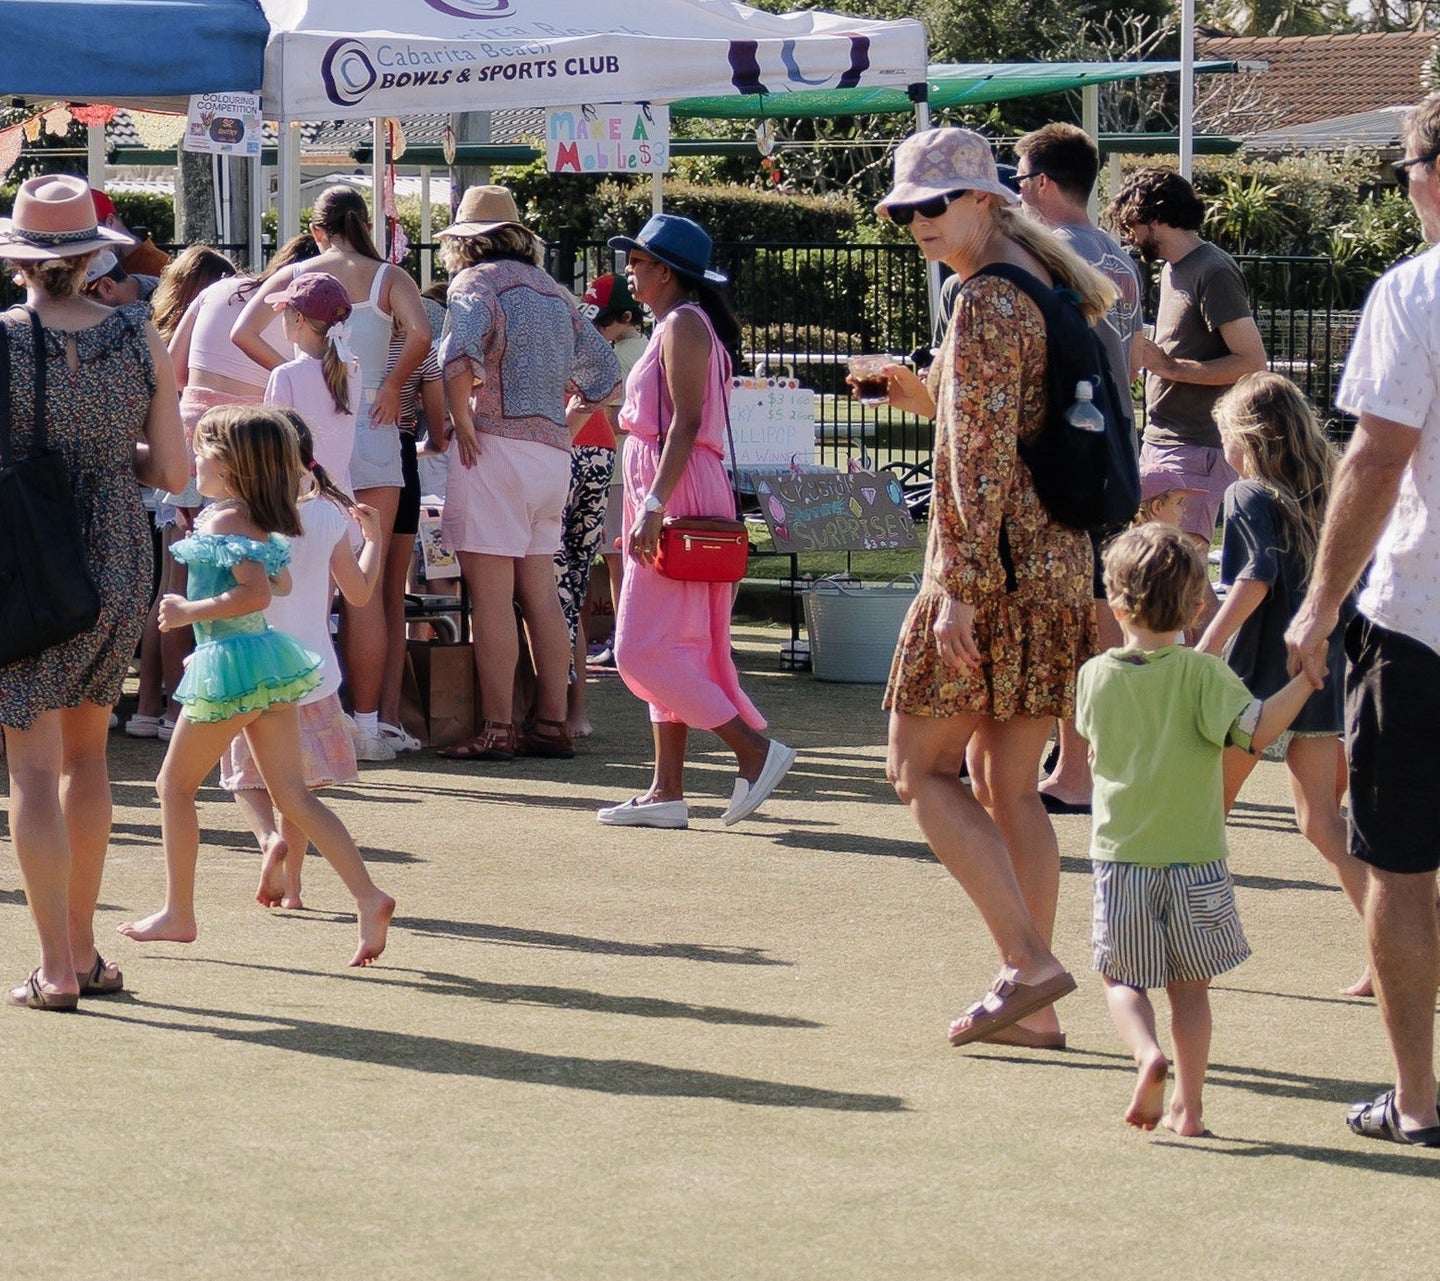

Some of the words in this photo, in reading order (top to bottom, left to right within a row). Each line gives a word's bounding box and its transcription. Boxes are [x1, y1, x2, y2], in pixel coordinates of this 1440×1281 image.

[377, 45, 474, 68] Cabarita
[481, 40, 553, 59] Beach
[378, 70, 453, 90] BOWLS
[455, 68, 472, 84] &
[478, 59, 558, 82] SPORTS
[564, 55, 620, 77] CLUB
[196, 101, 258, 114] COMPETITION
[202, 93, 255, 106] COLOURING
[550, 111, 622, 140] MAKE
[632, 114, 650, 140] A
[639, 141, 666, 167] $3
[724, 424, 796, 445] OLLIPOP
